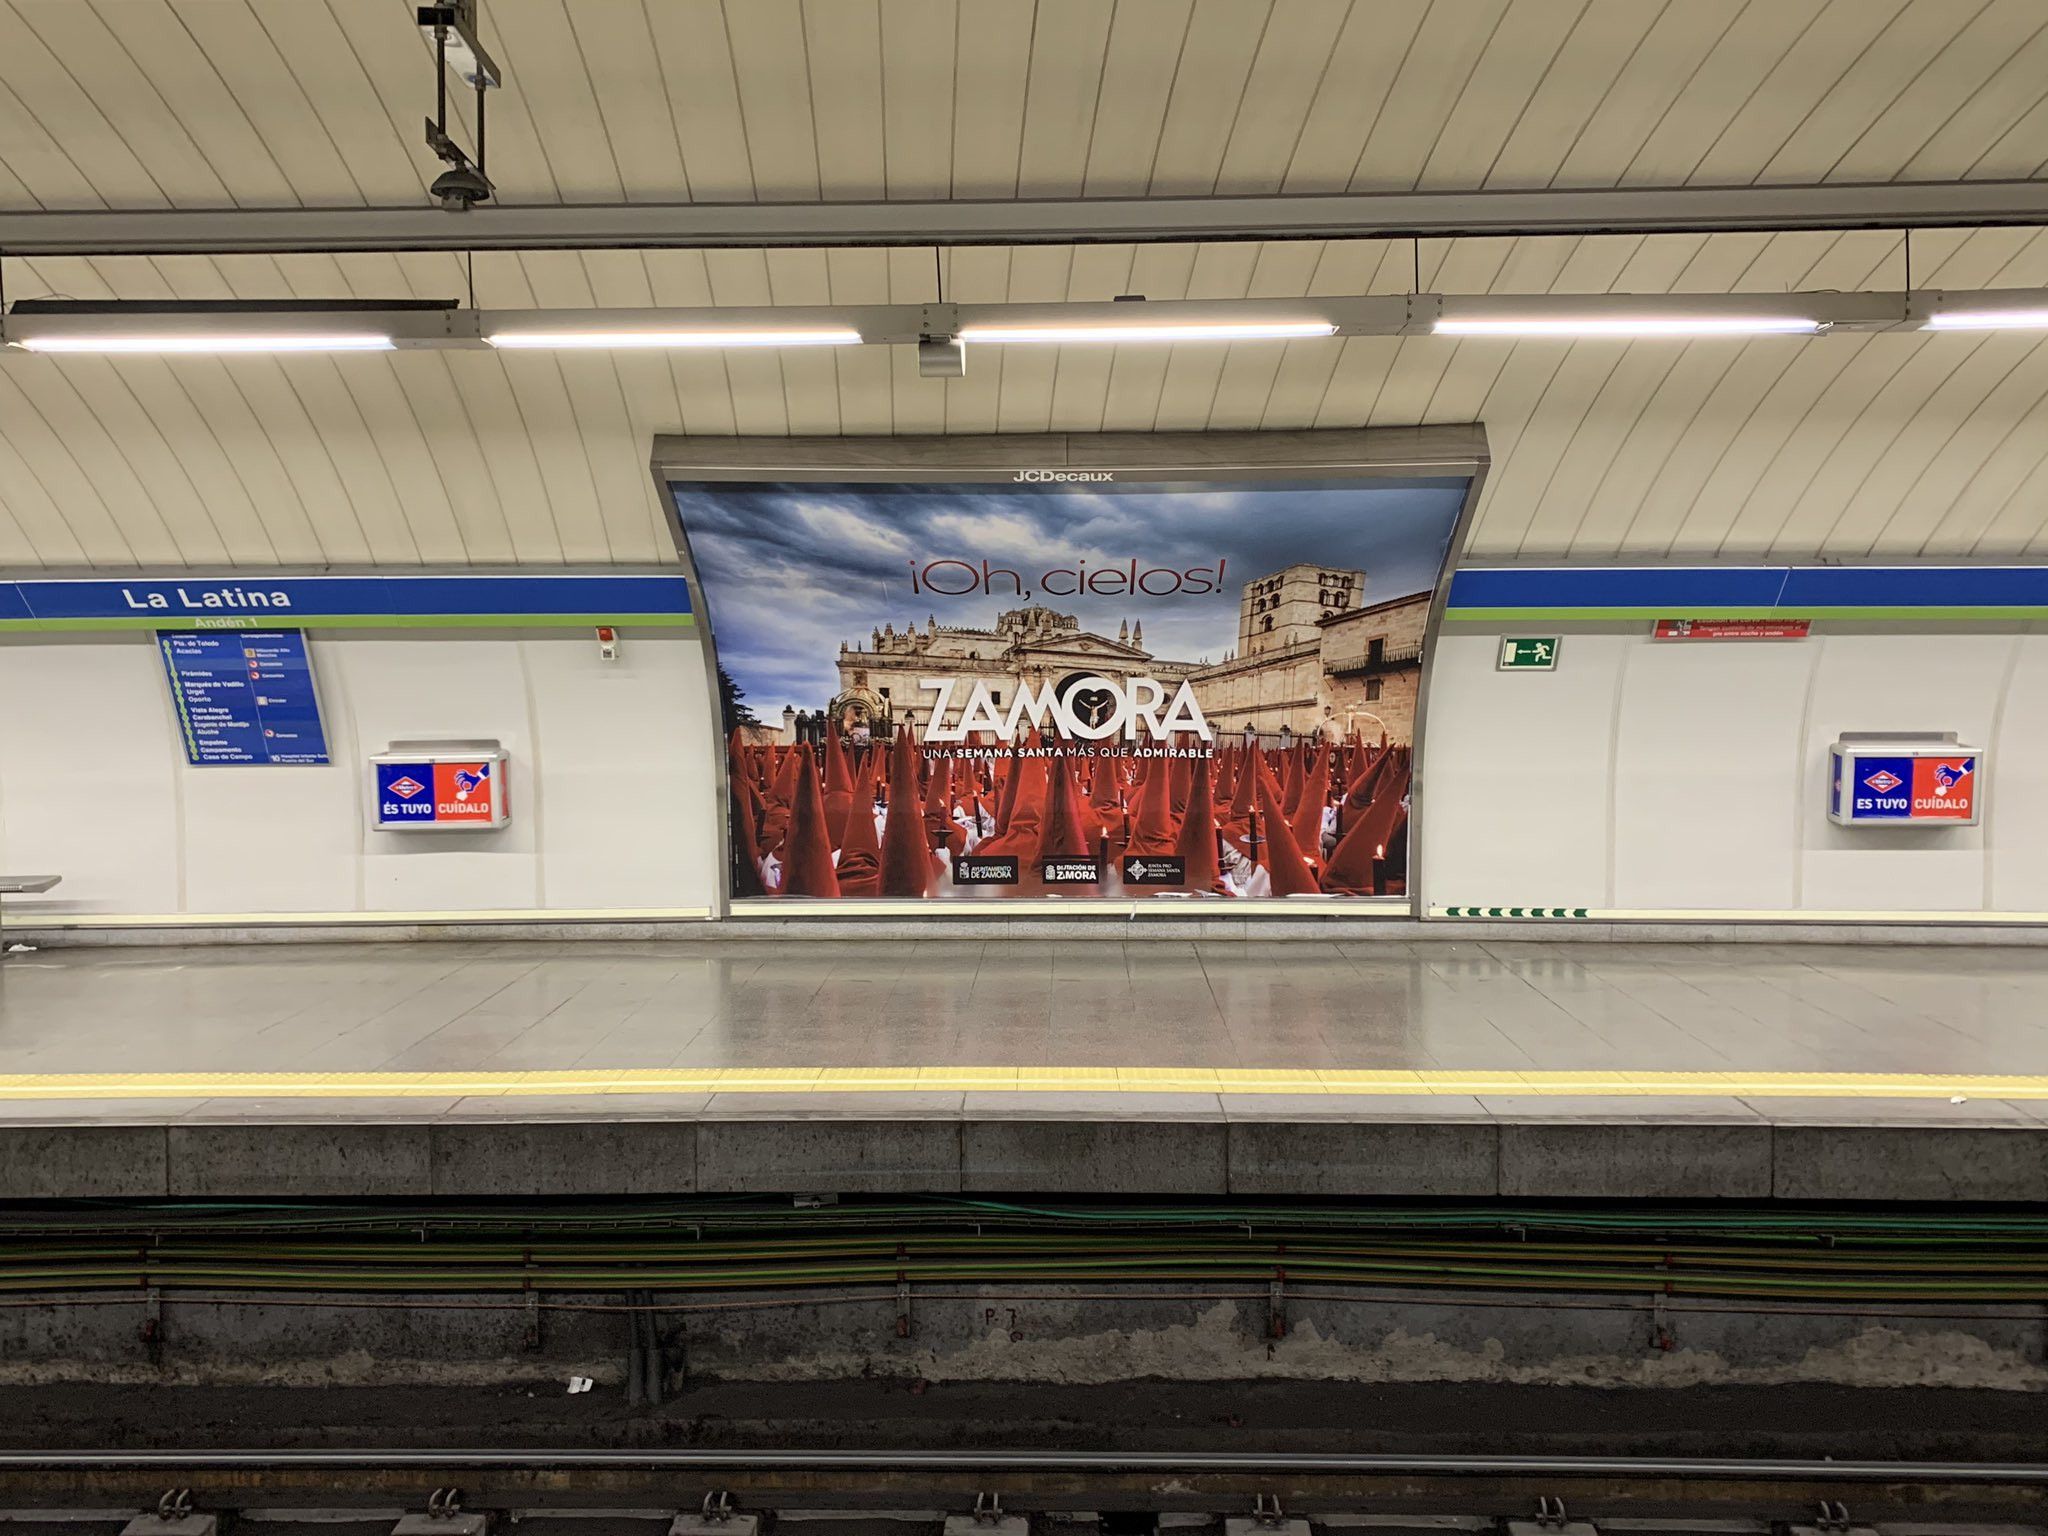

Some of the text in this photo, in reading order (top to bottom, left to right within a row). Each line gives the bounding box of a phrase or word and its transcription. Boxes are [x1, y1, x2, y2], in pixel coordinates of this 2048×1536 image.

[1013, 470, 1114, 482] JCDecaux
[910, 558, 1226, 601] ¡Oh, cielos!
[122, 587, 291, 608] La Latina
[195, 617, 258, 628] Andén 1
[920, 677, 1213, 741] ZAMORA
[923, 749, 951, 759] UNA
[956, 749, 1013, 758] SEMANA
[1018, 748, 1063, 758] SANTA
[1100, 748, 1128, 758] QUE
[1133, 748, 1213, 758] ADMIRABLE
[401, 803, 432, 814] TUYO
[438, 800, 489, 813] CUÍDALO
[1857, 796, 1968, 810] ES TUYO CUÍDALO
